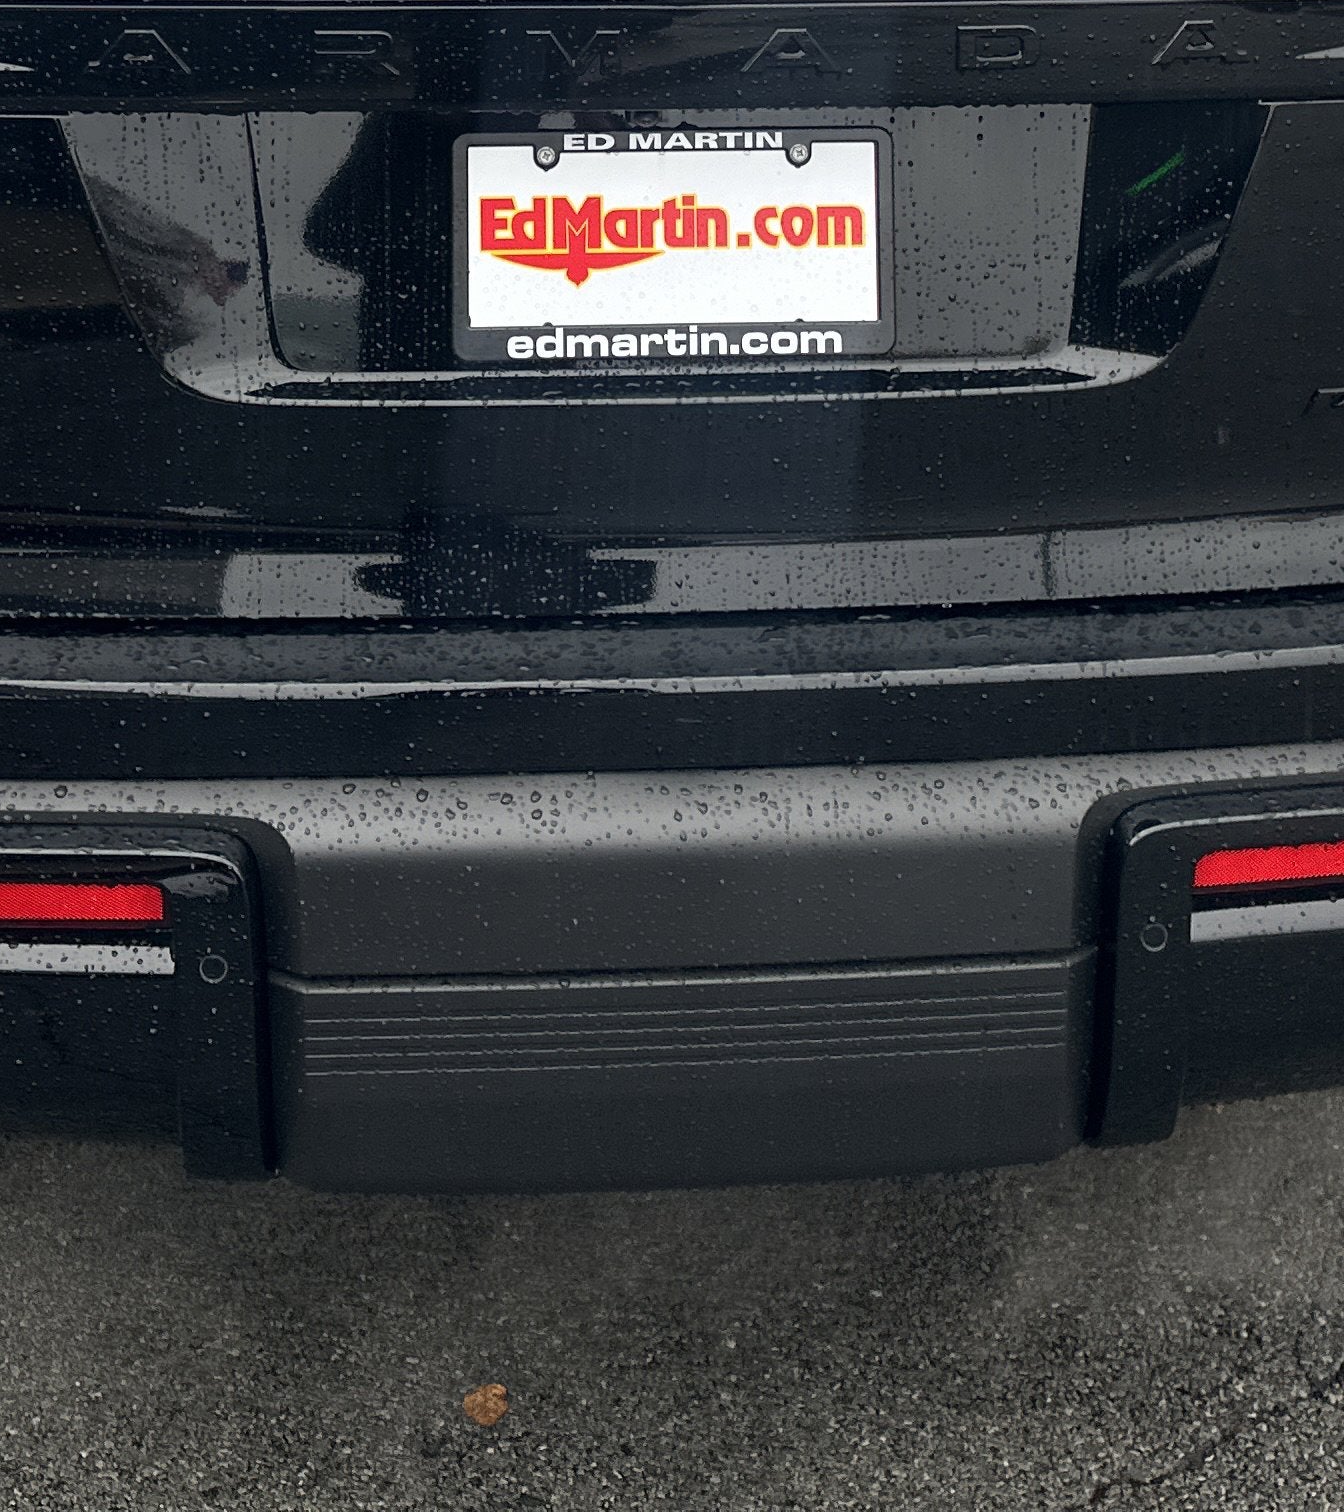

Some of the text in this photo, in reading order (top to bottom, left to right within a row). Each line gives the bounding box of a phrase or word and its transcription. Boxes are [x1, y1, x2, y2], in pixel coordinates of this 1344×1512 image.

[88, 20, 1250, 76] ARMADA
[562, 131, 784, 151] ED MARTIN
[479, 193, 865, 252] EdMartin.com
[506, 324, 844, 359] edmartin.com
